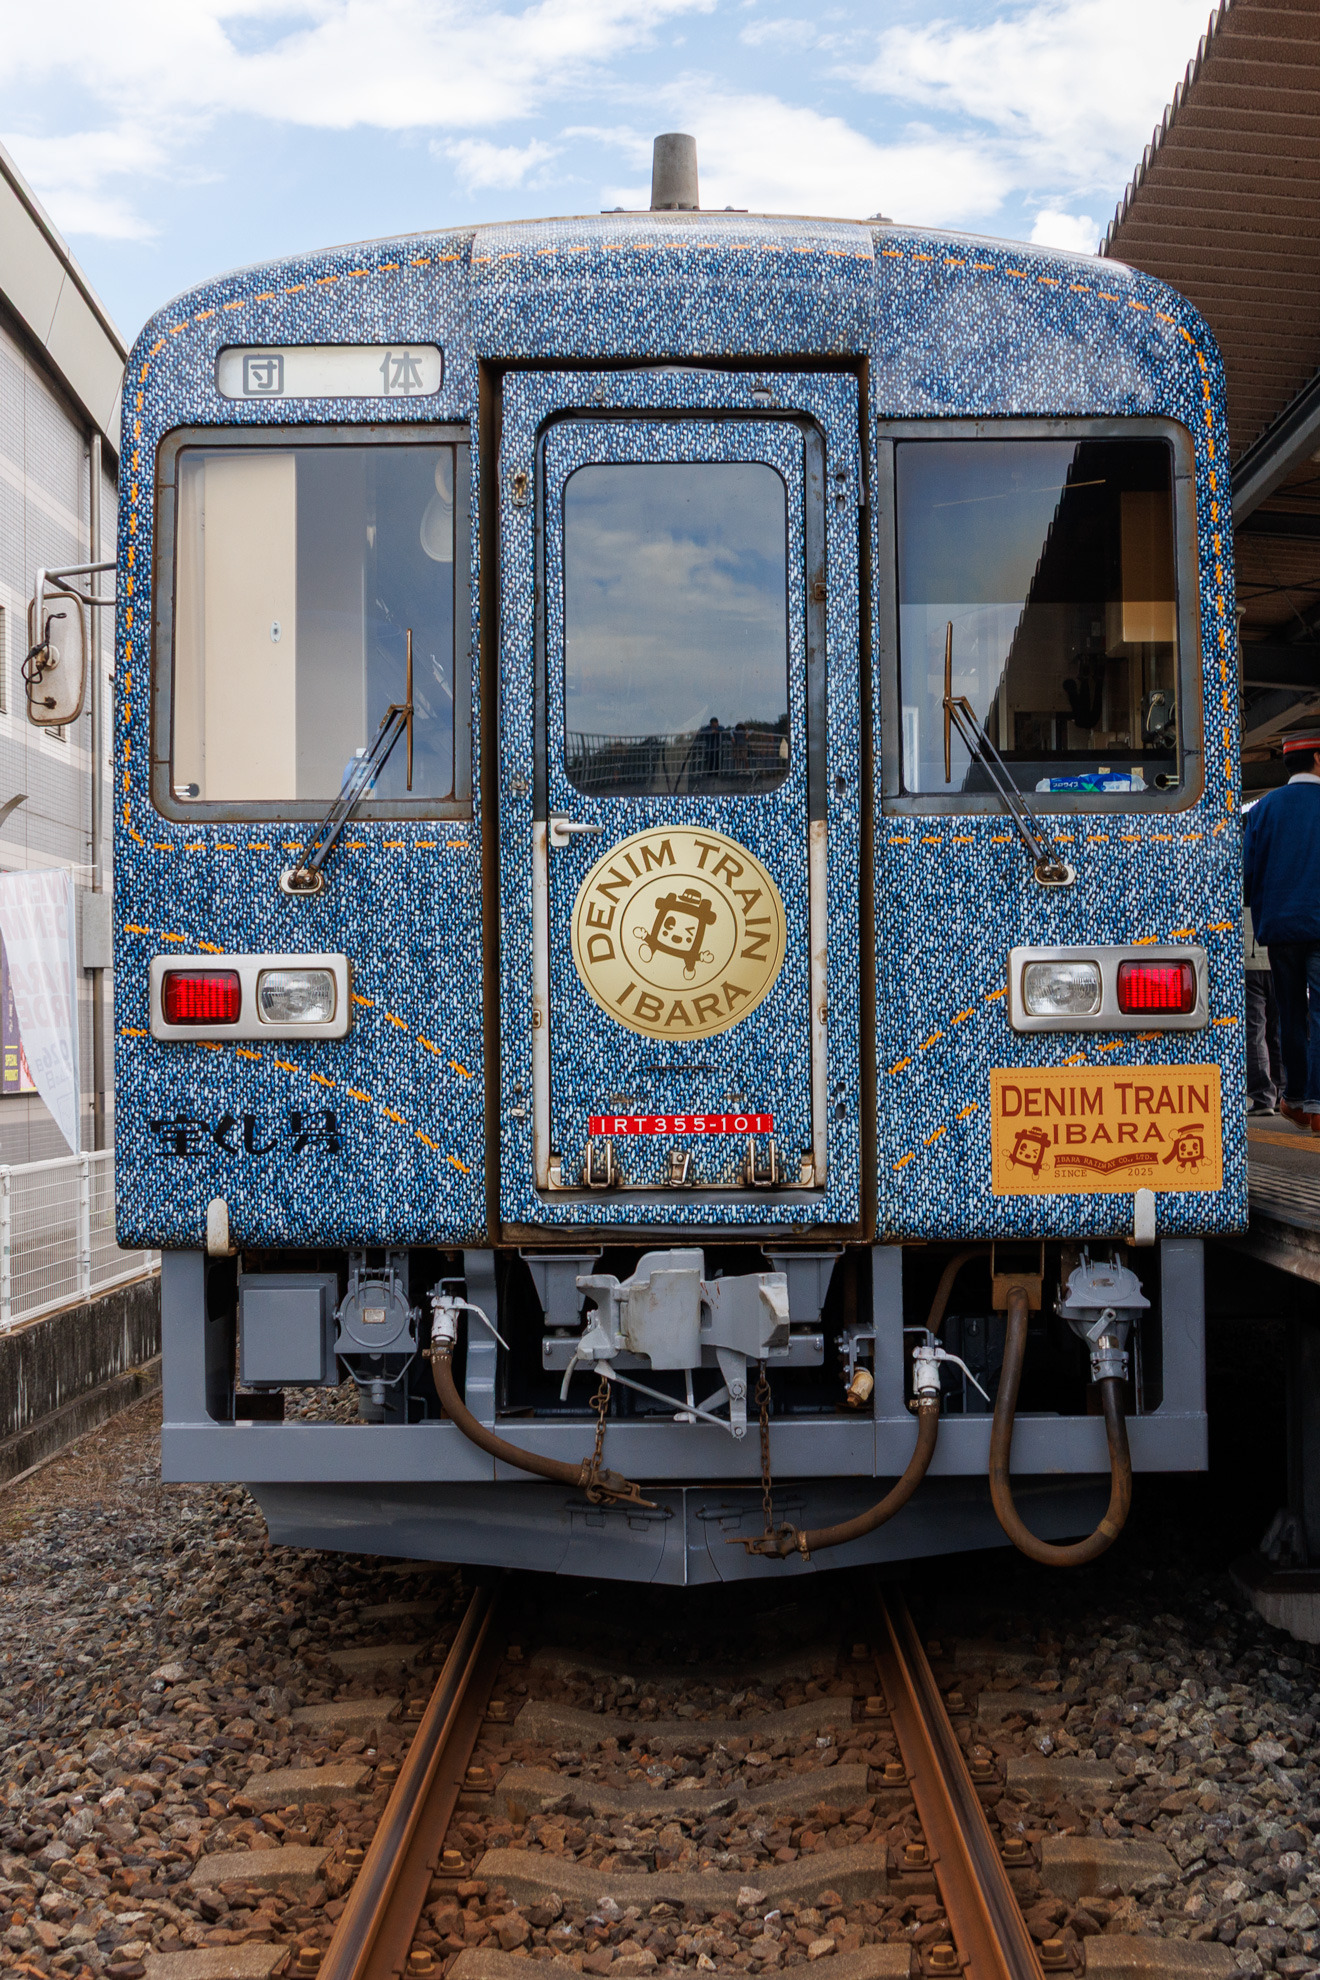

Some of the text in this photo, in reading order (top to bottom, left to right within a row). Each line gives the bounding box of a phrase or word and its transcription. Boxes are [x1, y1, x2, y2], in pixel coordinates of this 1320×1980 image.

[243, 351, 424, 395] 団体
[585, 839, 772, 964] DENIM TRAIN
[615, 980, 752, 1027] IBARA
[1001, 1081, 1210, 1117] DENIM TRAIN
[601, 1117, 762, 1133] IRT355-101
[1053, 1122, 1166, 1145] IBARA
[1054, 1168, 1154, 1178] SINCE 2025
[1083, 1158, 1116, 1169] RAILWAY
